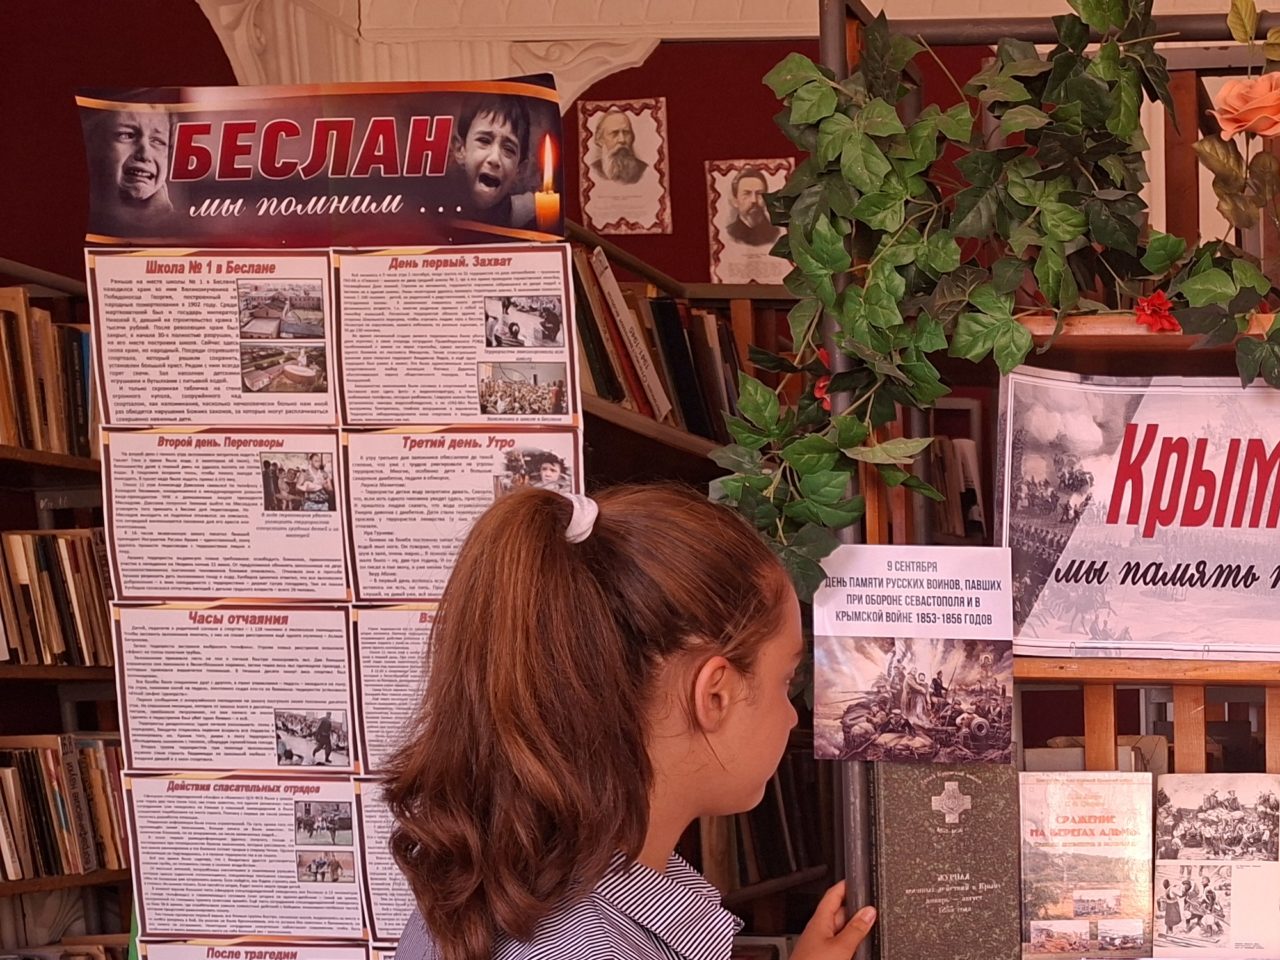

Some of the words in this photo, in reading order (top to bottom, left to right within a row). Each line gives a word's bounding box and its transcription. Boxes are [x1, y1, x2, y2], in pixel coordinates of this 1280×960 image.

[169, 115, 454, 182] БЕСЛАН
[189, 196, 246, 217] мы
[257, 195, 404, 217] помним
[146, 260, 185, 274] Школа
[188, 261, 202, 273] №
[206, 261, 212, 273] 1
[216, 264, 222, 273] в
[226, 261, 276, 274] Беслане
[388, 257, 419, 270] День
[422, 256, 469, 270] первый.
[473, 256, 512, 267] Захват
[158, 437, 192, 449] Второй
[194, 437, 220, 448] день.
[224, 437, 284, 449] Переговоры
[402, 436, 446, 450] Третий
[448, 437, 482, 450] день.
[486, 436, 515, 450] Утро
[887, 561, 892, 571] 9
[895, 561, 938, 573] СЕНТЯБРЯ
[1054, 558, 1112, 586] мы
[1118, 559, 1261, 590] память
[825, 577, 847, 588] ДЕНЬ
[849, 577, 884, 588] ПАМЯТИ
[886, 578, 924, 589] РУССКИХ
[927, 578, 963, 591] ВОИНОВ,
[965, 580, 1001, 591] ПАВШИХ
[846, 594, 863, 605] ПРИ
[865, 594, 902, 606] ОБОРОНЕ
[905, 595, 965, 607] СЕВАСТОПОЛЯ
[967, 597, 972, 606] И
[975, 597, 980, 608] В
[188, 612, 225, 625] Часы
[227, 613, 288, 625] отчаяния
[836, 610, 884, 622] КРЫМСКОЙ
[886, 610, 912, 623] ВОЙНЕ
[916, 613, 962, 624] 1853-1856
[964, 614, 992, 625] ГОДОВ
[167, 781, 211, 793] Действия
[213, 782, 282, 793] спасательных
[284, 784, 320, 795] отрядов
[206, 948, 240, 960] После
